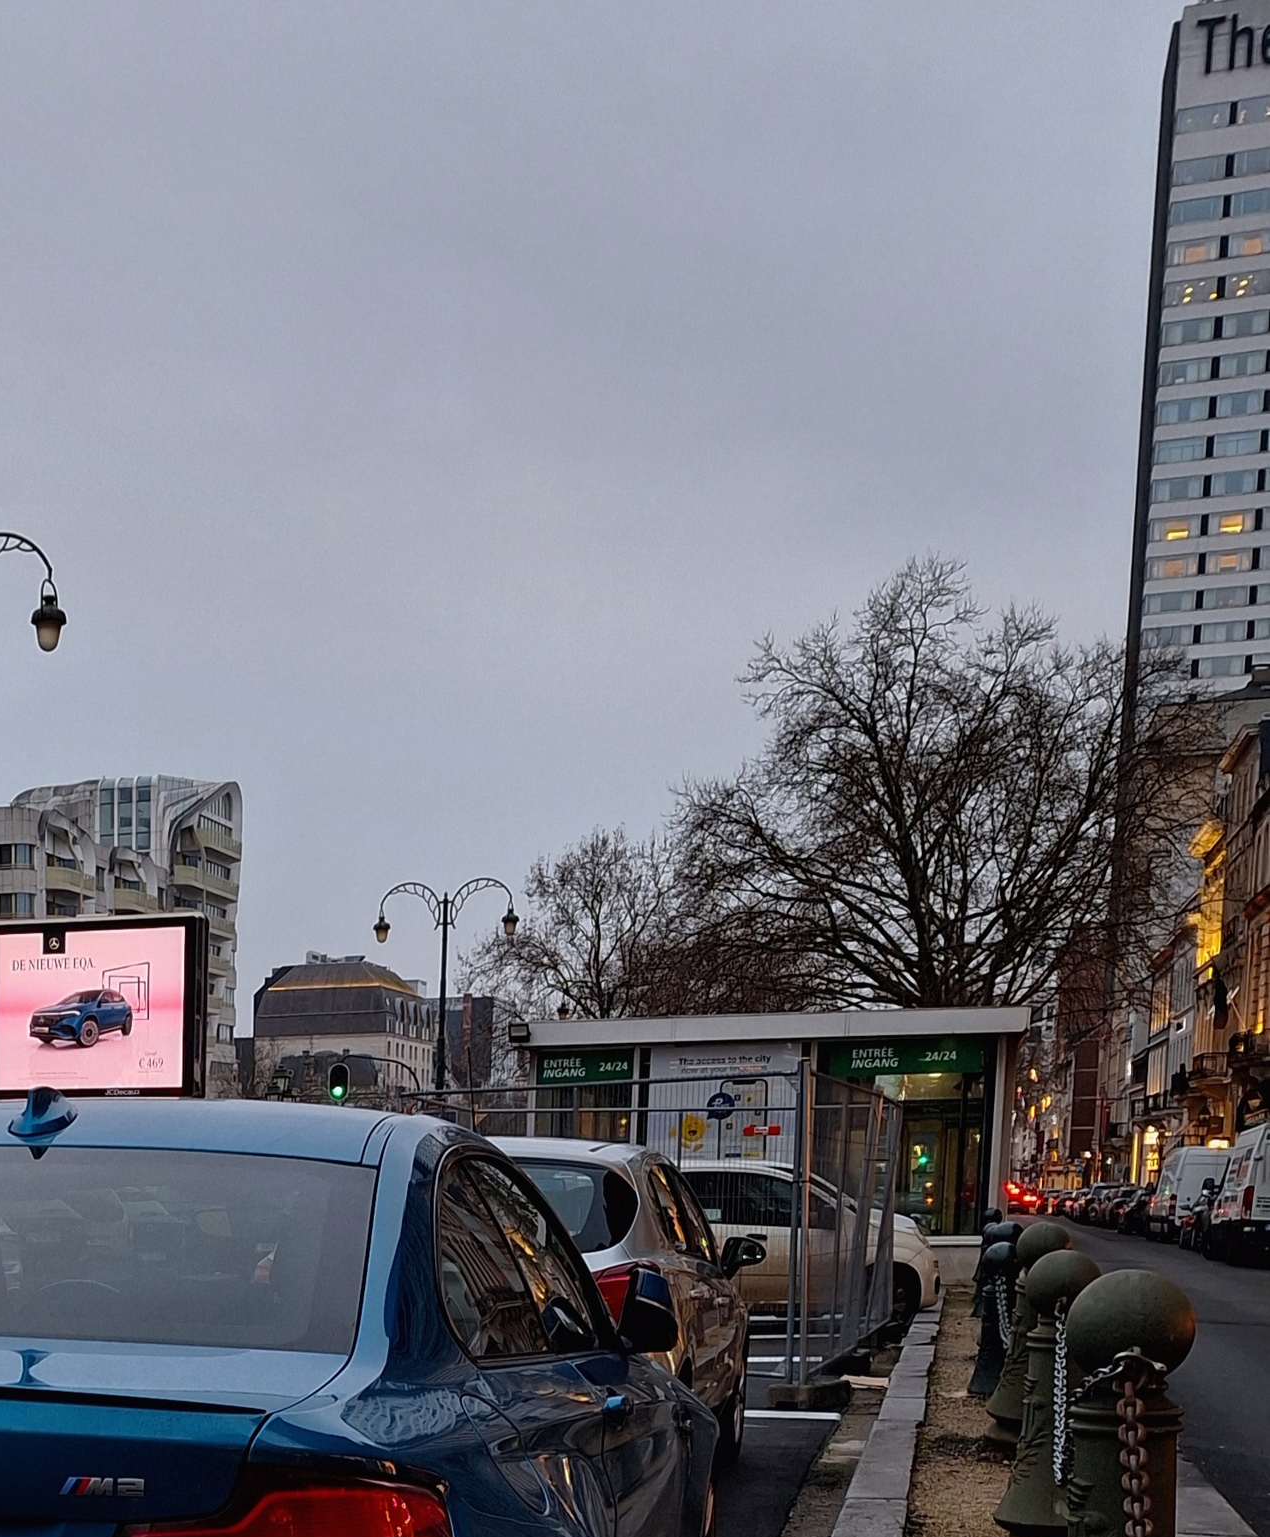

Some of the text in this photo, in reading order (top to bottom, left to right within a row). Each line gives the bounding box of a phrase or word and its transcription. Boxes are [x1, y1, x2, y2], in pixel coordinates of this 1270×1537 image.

[12, 960, 26, 971] DE
[28, 958, 70, 971] NIEUWE
[739, 1055, 754, 1063] the
[755, 1055, 771, 1063] city
[852, 1046, 957, 1061] ENTRÉE 24/24
[147, 1057, 164, 1069] 469
[543, 1057, 628, 1072] ENTRÉE 24/24
[851, 1058, 899, 1069] INGANG
[543, 1067, 586, 1079] INGANG
[78, 1477, 145, 1497] M2
